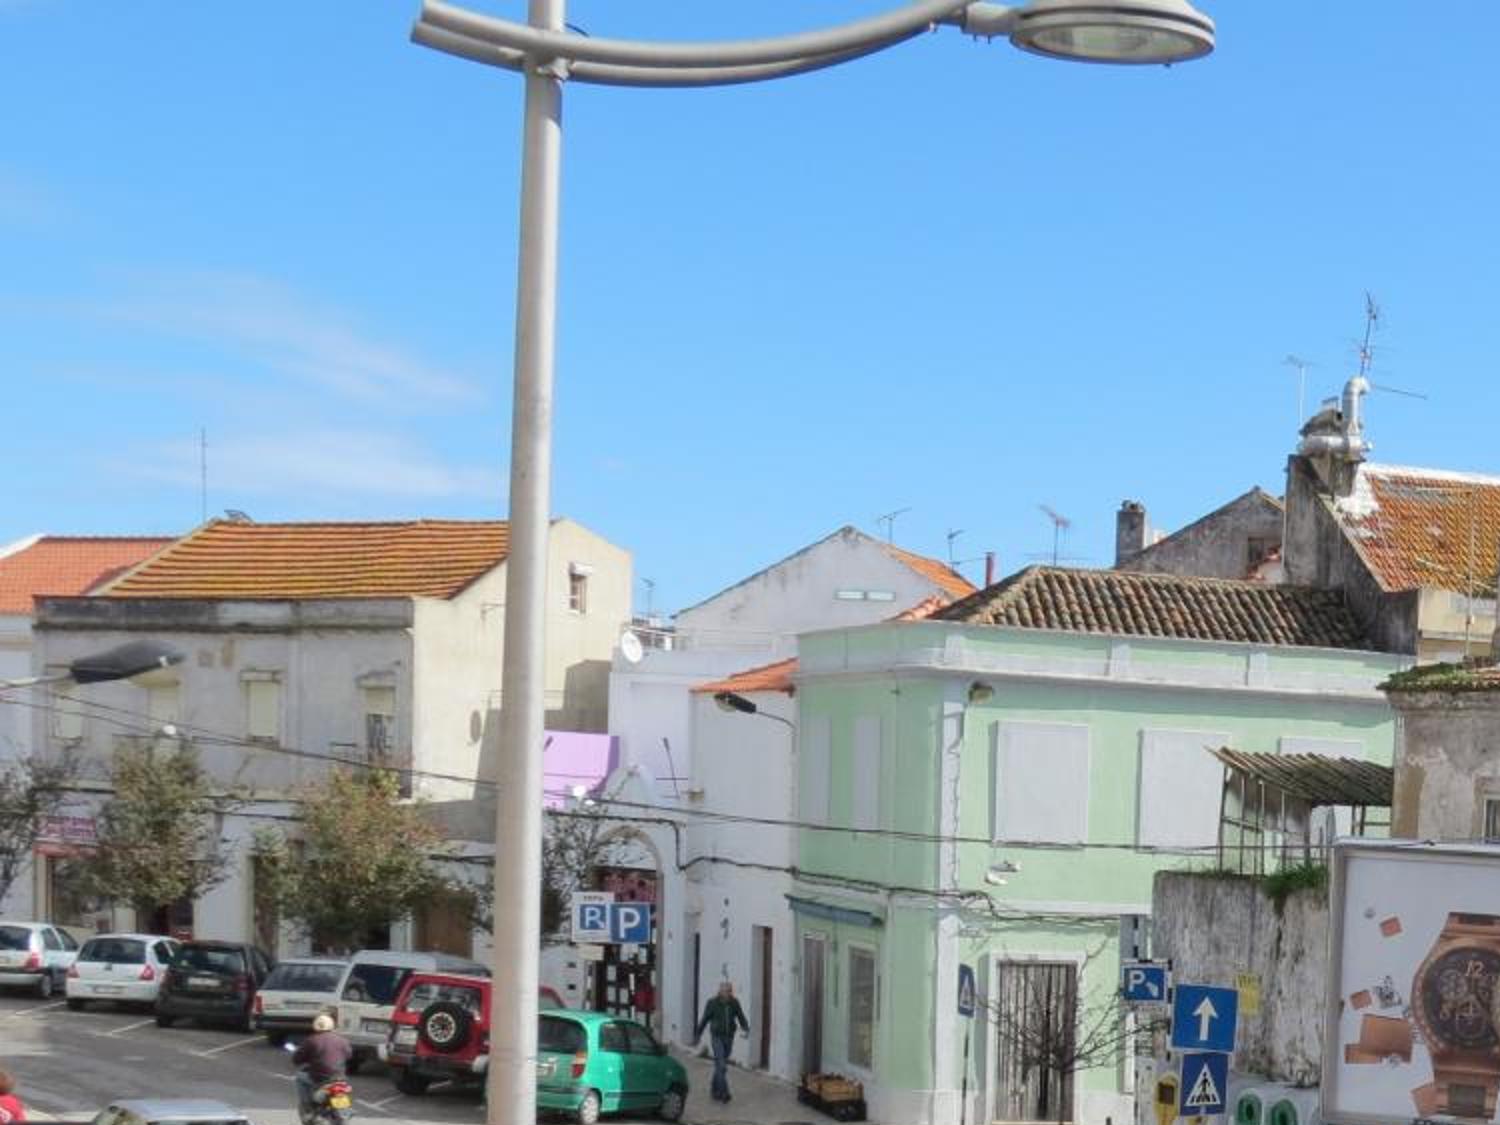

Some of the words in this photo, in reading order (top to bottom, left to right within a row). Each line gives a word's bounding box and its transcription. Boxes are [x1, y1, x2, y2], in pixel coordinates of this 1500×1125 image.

[584, 906, 605, 929] R
[618, 907, 641, 939] P
[1128, 970, 1145, 993] P
